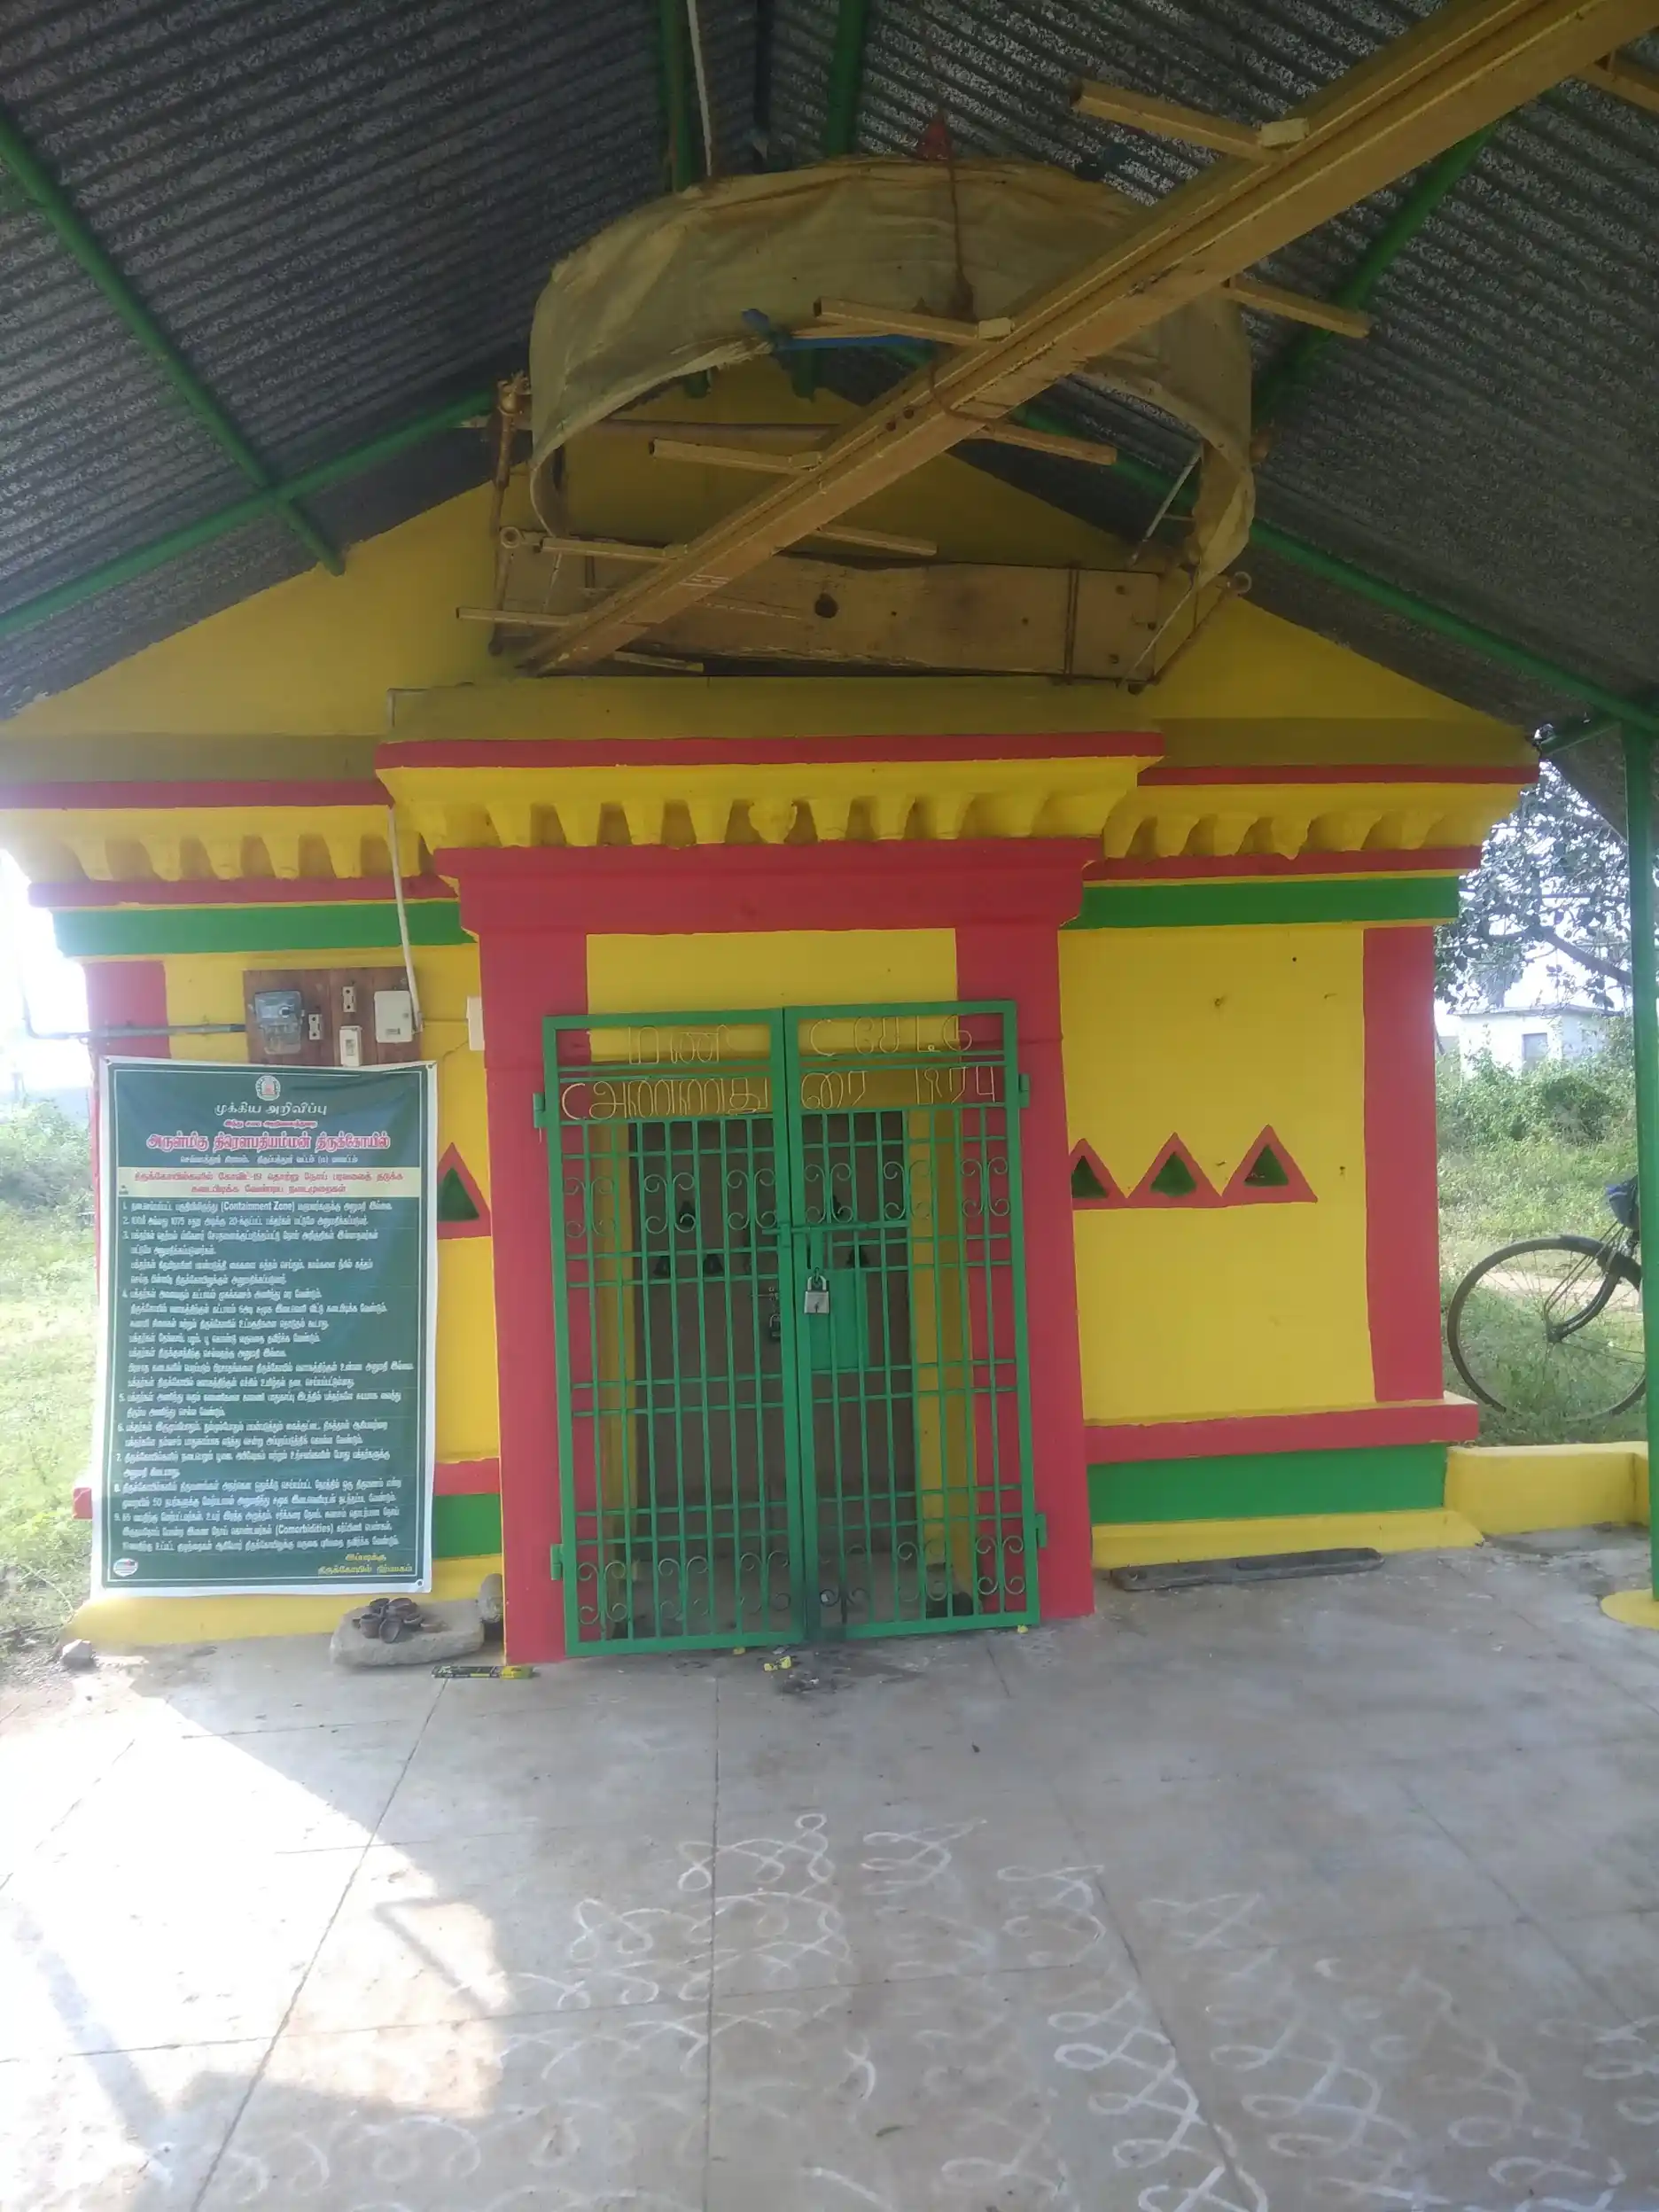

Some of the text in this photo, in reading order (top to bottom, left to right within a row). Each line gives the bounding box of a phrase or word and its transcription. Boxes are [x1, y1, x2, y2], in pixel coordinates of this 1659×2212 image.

[214, 1102, 327, 1116] முக்கிய அறிவிப்பு
[146, 1130, 209, 1152] அருள்மிகு
[315, 1130, 391, 1153] திருக்கோயில்
[221, 1201, 271, 1212] (Containment
[274, 1201, 295, 1212] Zone)
